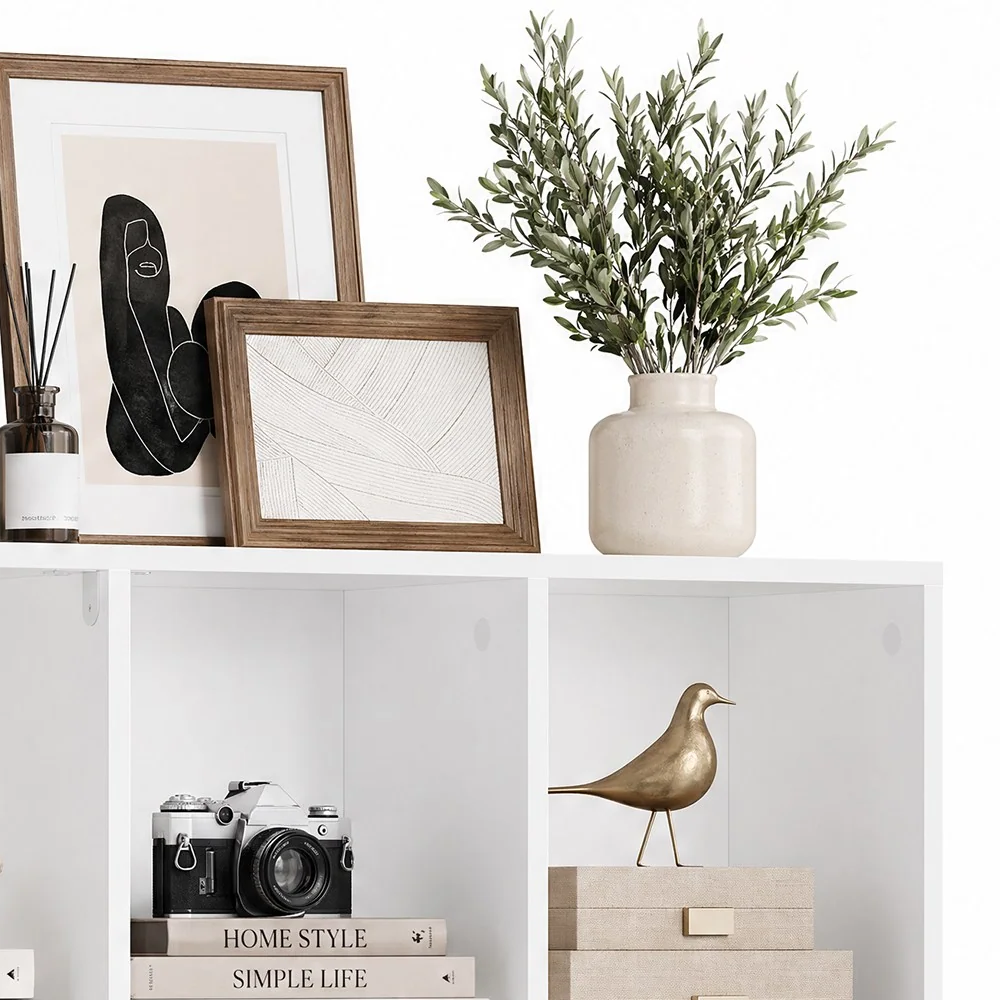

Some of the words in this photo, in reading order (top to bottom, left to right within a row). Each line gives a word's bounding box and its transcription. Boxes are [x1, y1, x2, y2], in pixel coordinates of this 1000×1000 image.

[224, 928, 293, 949] HOME
[298, 928, 368, 949] STYLE
[233, 969, 314, 989] SIMPLE
[321, 969, 368, 989] LIFE
